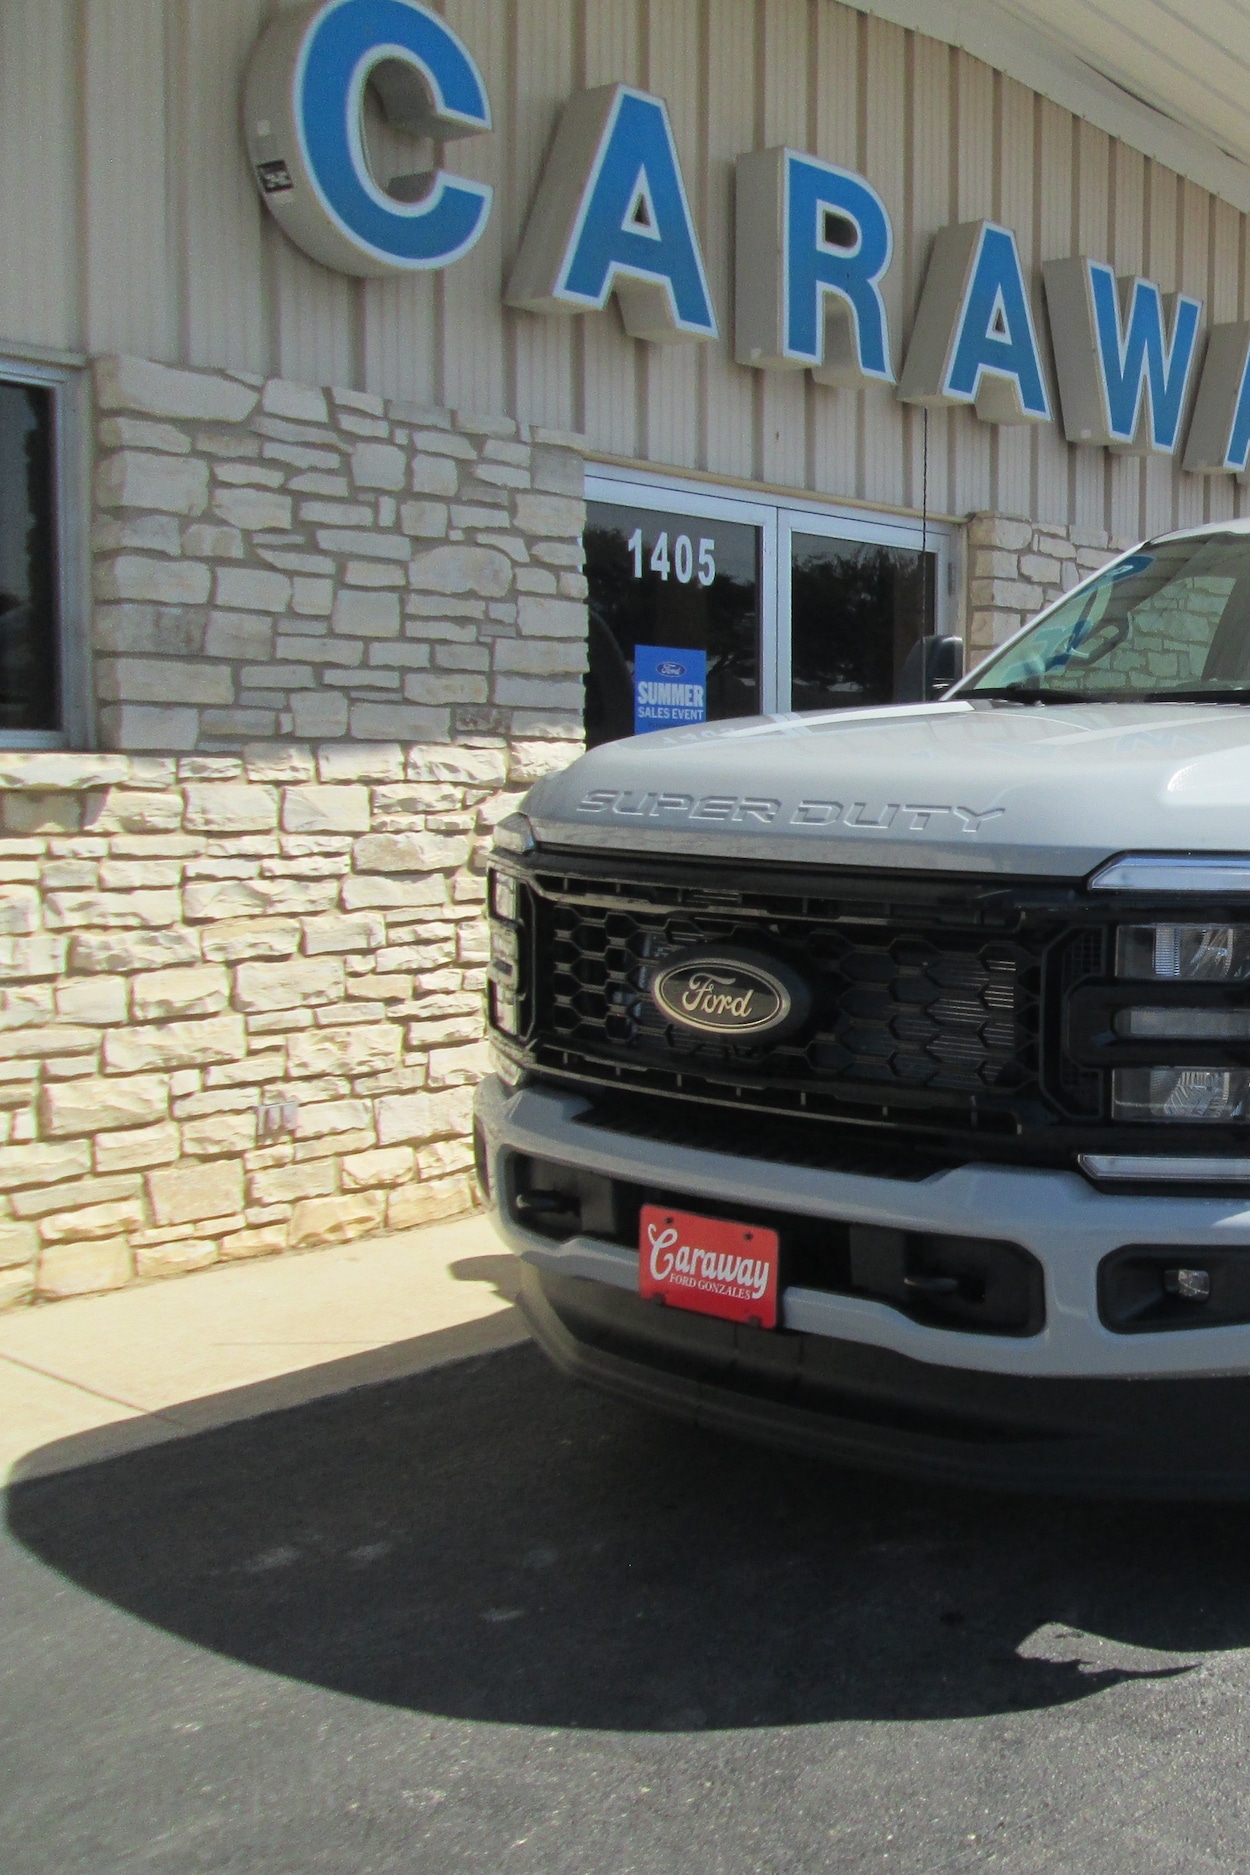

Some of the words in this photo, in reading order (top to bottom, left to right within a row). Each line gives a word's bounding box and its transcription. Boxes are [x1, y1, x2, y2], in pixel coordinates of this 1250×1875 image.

[627, 528, 717, 586] 1405
[637, 681, 704, 708] SUMMER
[637, 706, 670, 719] SALES
[671, 708, 704, 721] EVENT
[576, 788, 782, 824] SUPER
[788, 799, 1007, 833] DUTY
[681, 972, 755, 1018] Ford
[647, 1223, 770, 1300] Caraway
[669, 1273, 697, 1289] FORD
[697, 1279, 752, 1301] GONZALES
